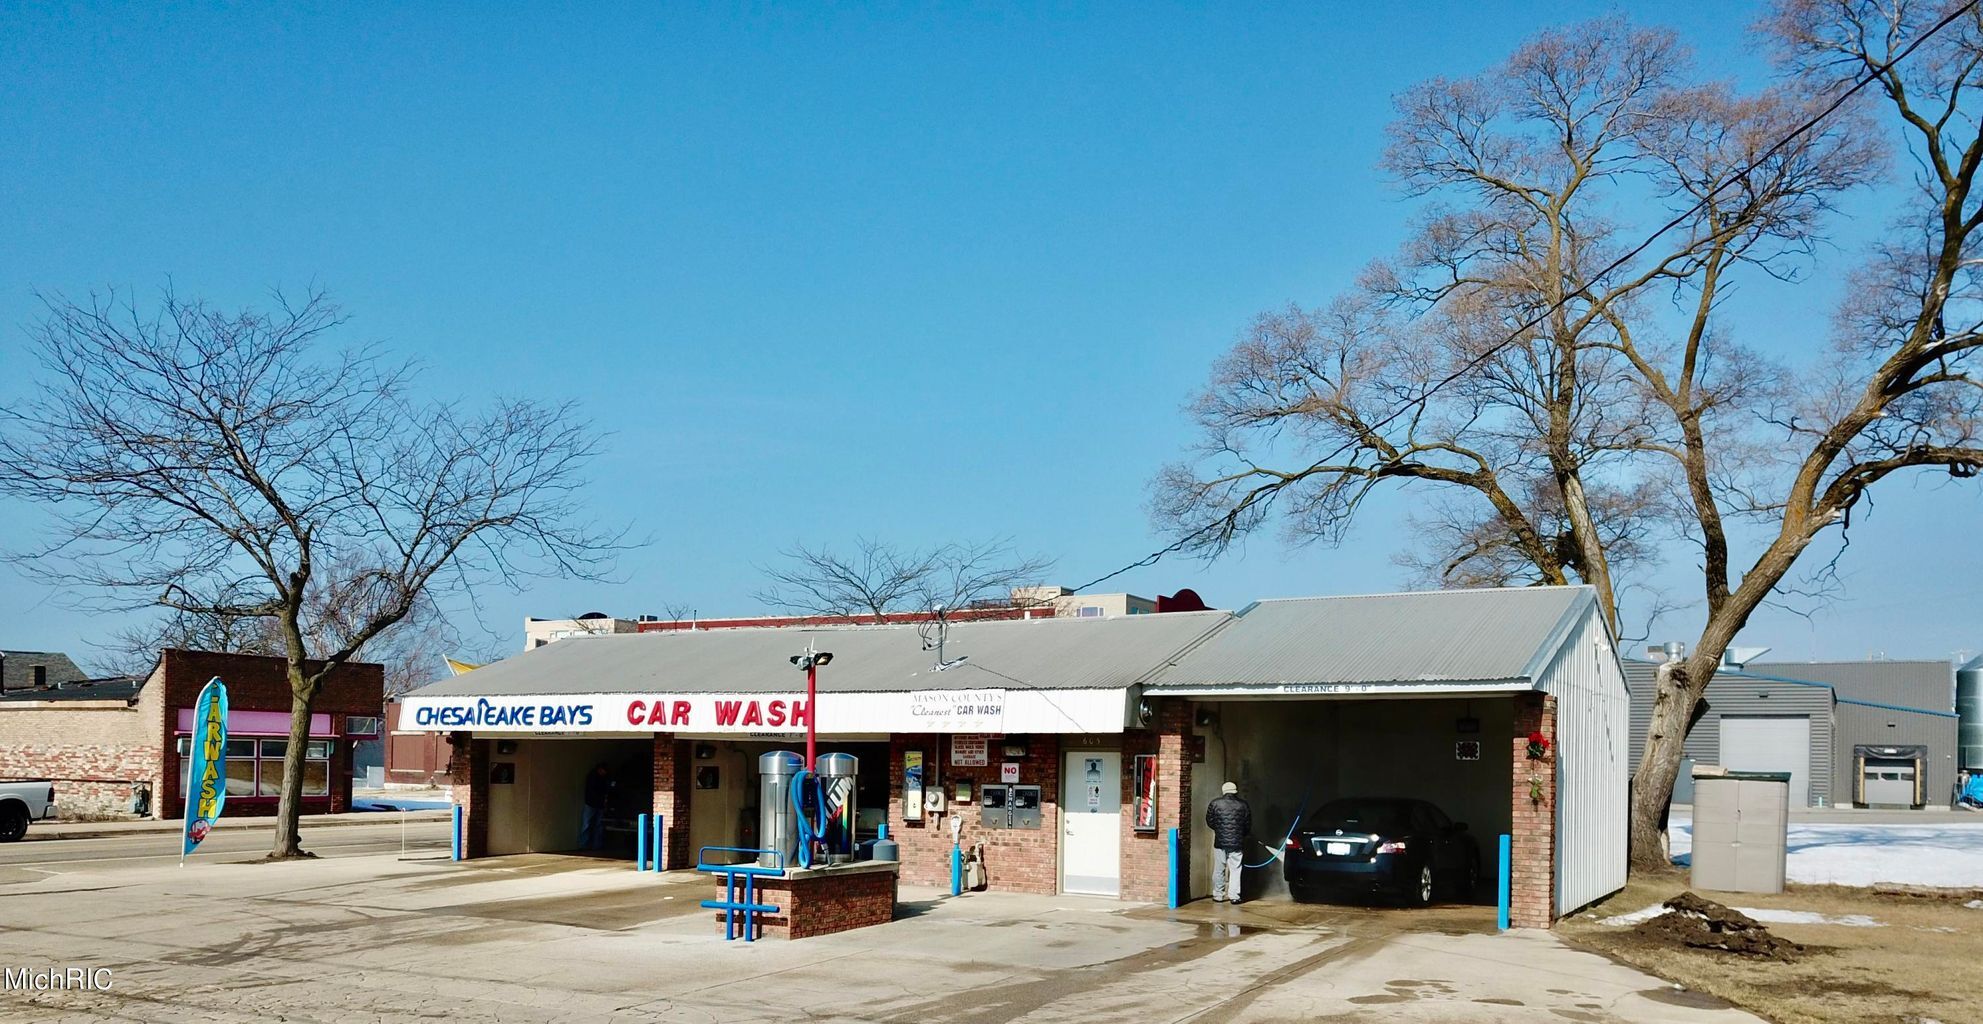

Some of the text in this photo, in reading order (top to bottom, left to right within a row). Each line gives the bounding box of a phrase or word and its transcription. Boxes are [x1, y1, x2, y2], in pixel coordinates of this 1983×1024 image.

[1283, 685, 1340, 693] CLEARANCE
[627, 700, 811, 727] CAR WASH
[957, 705, 974, 715] CAR
[977, 705, 1002, 715] WASH
[539, 705, 593, 726] BAYS
[1004, 767, 1017, 775] NO
